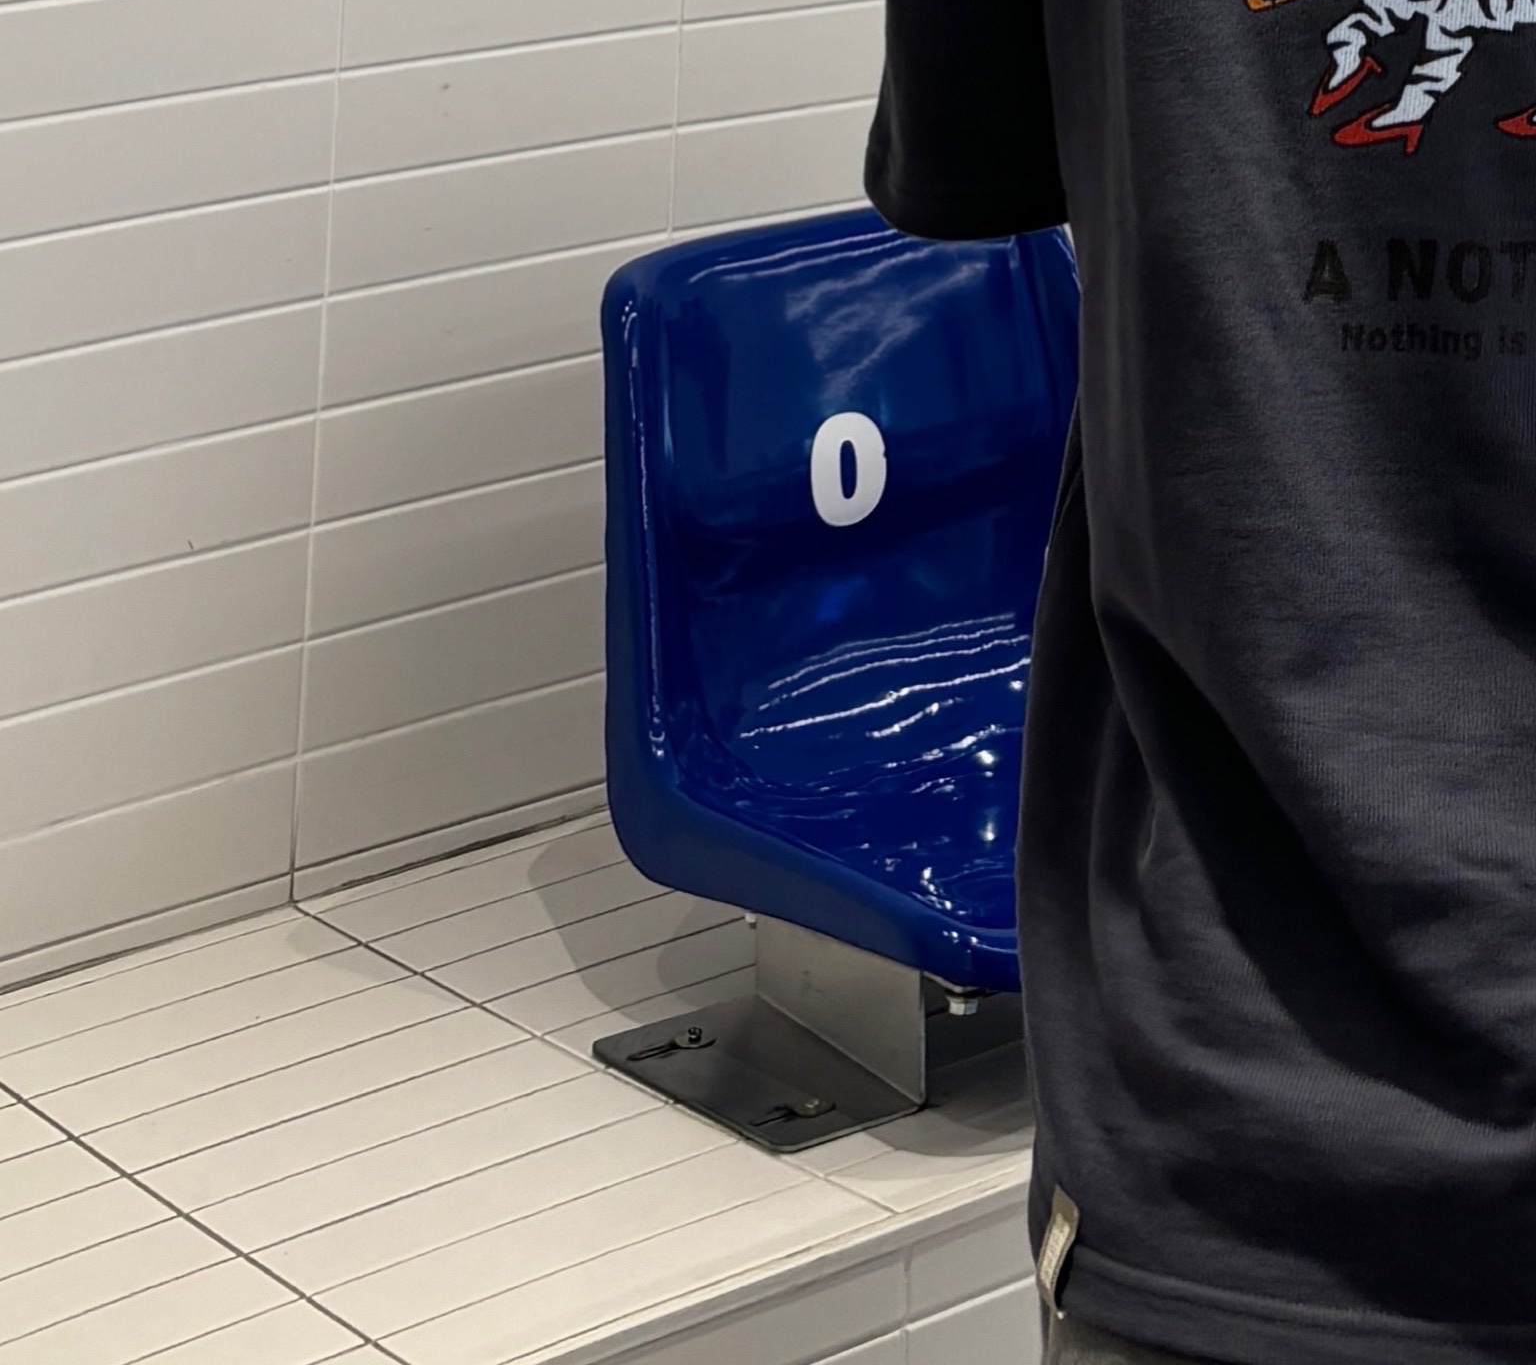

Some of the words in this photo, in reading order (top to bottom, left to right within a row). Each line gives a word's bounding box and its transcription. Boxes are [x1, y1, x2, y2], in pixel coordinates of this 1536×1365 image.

[1303, 238, 1354, 303] A
[1340, 322, 1483, 362] Nothing
[1497, 323, 1528, 358] is
[809, 410, 888, 528] 0
